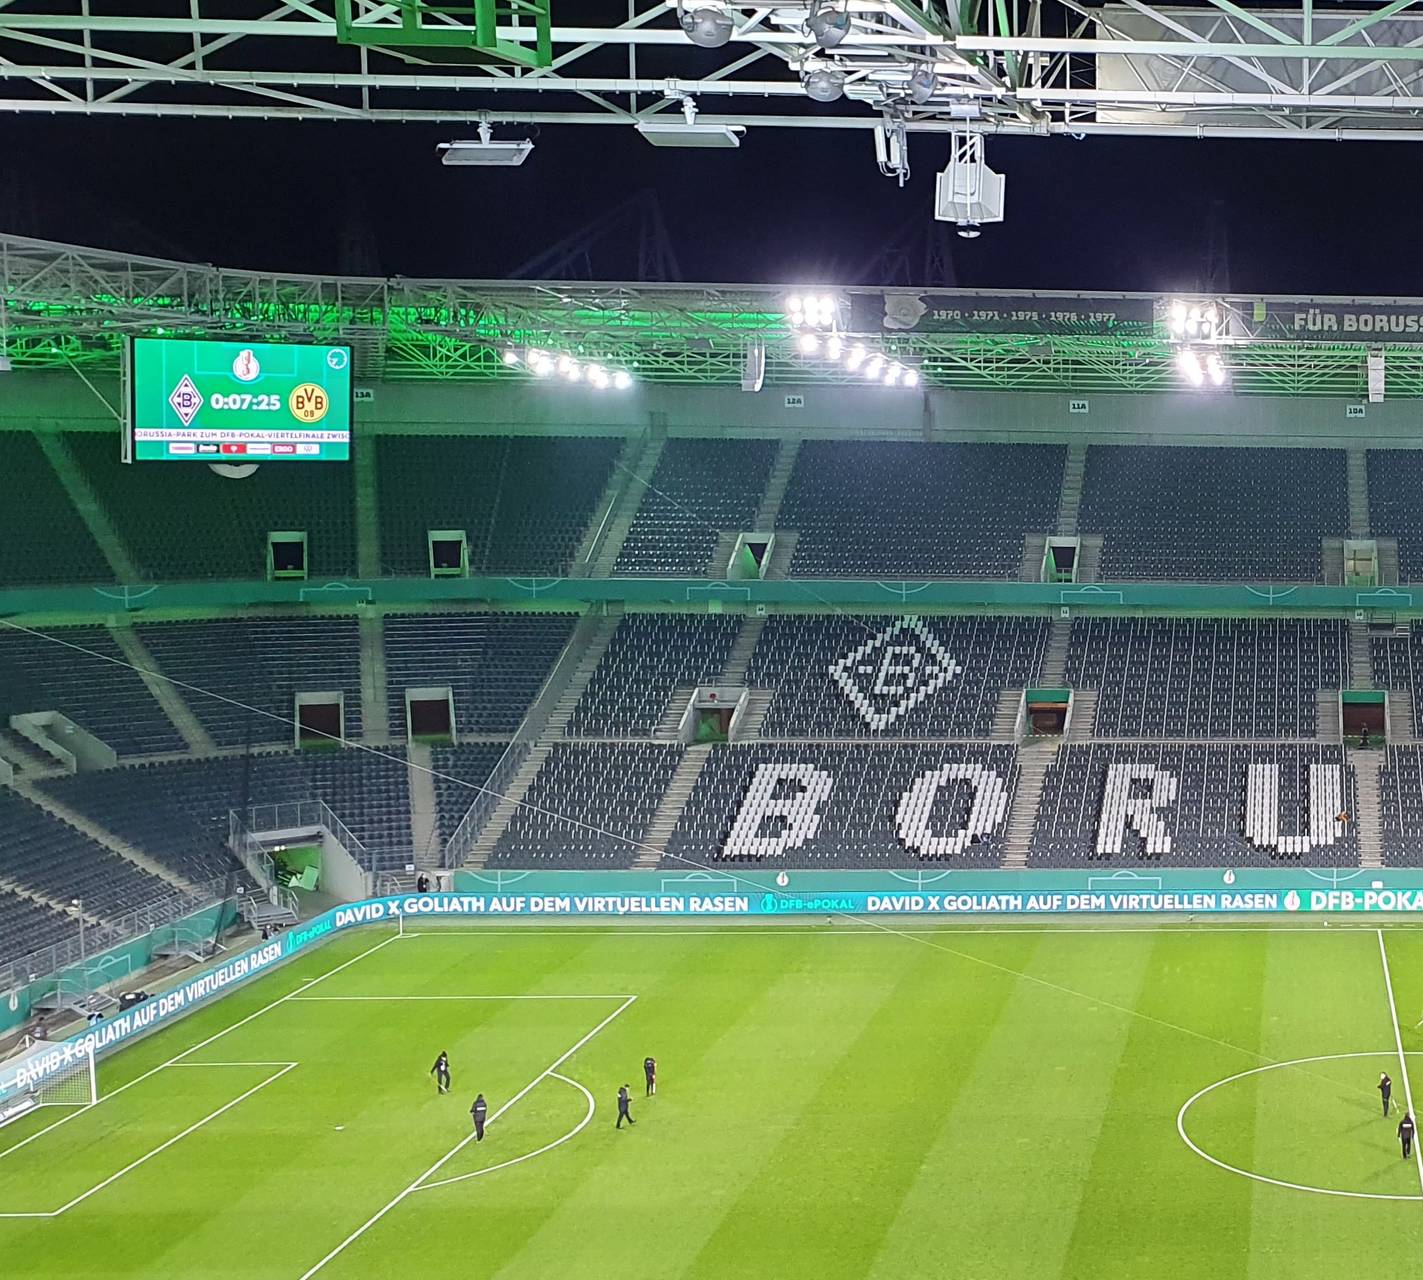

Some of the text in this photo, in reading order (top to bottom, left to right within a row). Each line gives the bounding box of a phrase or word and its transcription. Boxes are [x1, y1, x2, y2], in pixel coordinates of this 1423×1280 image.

[932, 310, 1116, 322] 1970 1971 1975 1976 1977
[1294, 308, 1338, 331] FÜR
[210, 393, 281, 411] 0:07:25
[296, 388, 324, 411] BVB
[355, 390, 371, 398] 13A
[786, 397, 802, 405] 12A
[135, 430, 197, 439] ORUSSIA-PARK
[200, 431, 218, 439] ZUM
[780, 898, 855, 910] DFB-ePOKAL
[867, 894, 1277, 911] DAVID X GOLIATH AUF DEM VIRTUELLEN RASEN
[335, 896, 749, 928] DAVID X GOLIATH AUF DEM VIRTUELLEN RASEN
[75, 1016, 131, 1058] GOLIATH
[132, 1003, 160, 1033] AUF
[159, 990, 185, 1017] DEM
[184, 954, 249, 1002] VIRTUELLEN
[250, 941, 282, 970] RASEN
